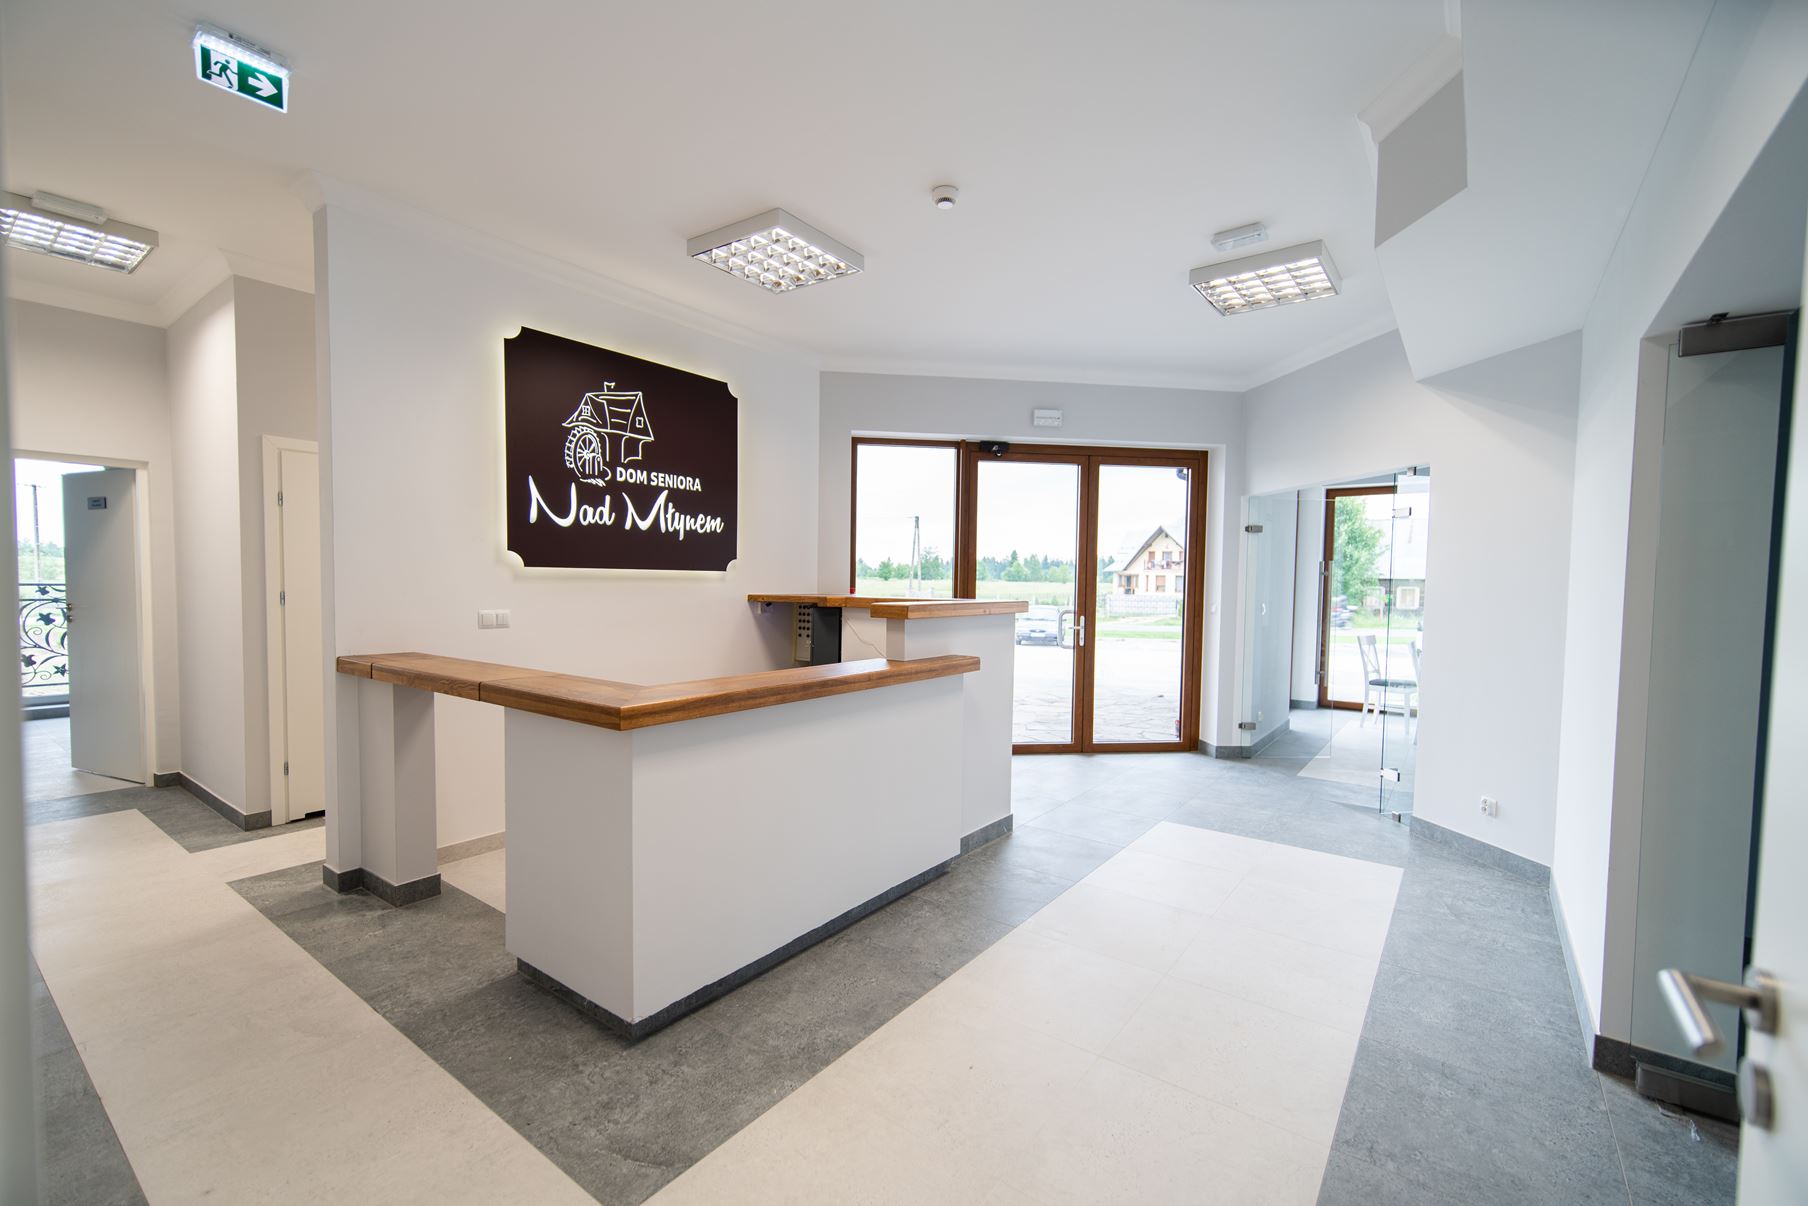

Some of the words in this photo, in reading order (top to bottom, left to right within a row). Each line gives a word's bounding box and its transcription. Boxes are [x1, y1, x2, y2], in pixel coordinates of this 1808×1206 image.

[616, 466, 648, 485] DOM
[650, 471, 702, 492] SENIORA
[528, 475, 616, 528] Nad
